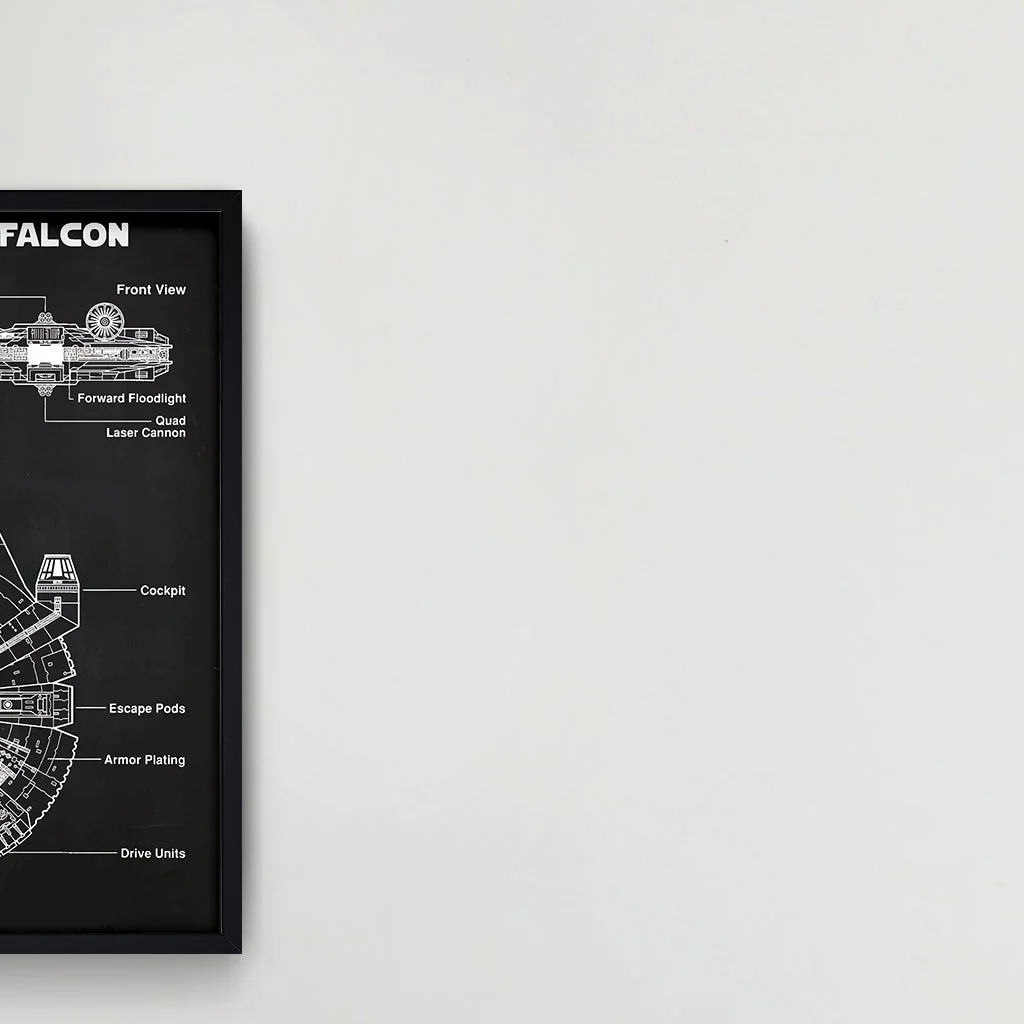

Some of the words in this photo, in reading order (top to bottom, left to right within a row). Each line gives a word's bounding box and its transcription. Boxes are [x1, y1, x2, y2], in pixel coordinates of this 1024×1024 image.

[116, 283, 152, 296] Front
[155, 283, 187, 296] View
[77, 392, 125, 404] Forward
[128, 392, 187, 406] Floodlight
[155, 415, 186, 426] Quad
[106, 427, 139, 438] Laser
[141, 427, 186, 438] Cannon
[140, 584, 186, 599] Cockpit
[109, 702, 153, 717] Escape
[155, 702, 186, 714] Pods
[104, 753, 142, 765] Armor
[144, 754, 186, 768] Plating
[120, 847, 152, 859] Drive
[155, 847, 186, 859] Units
